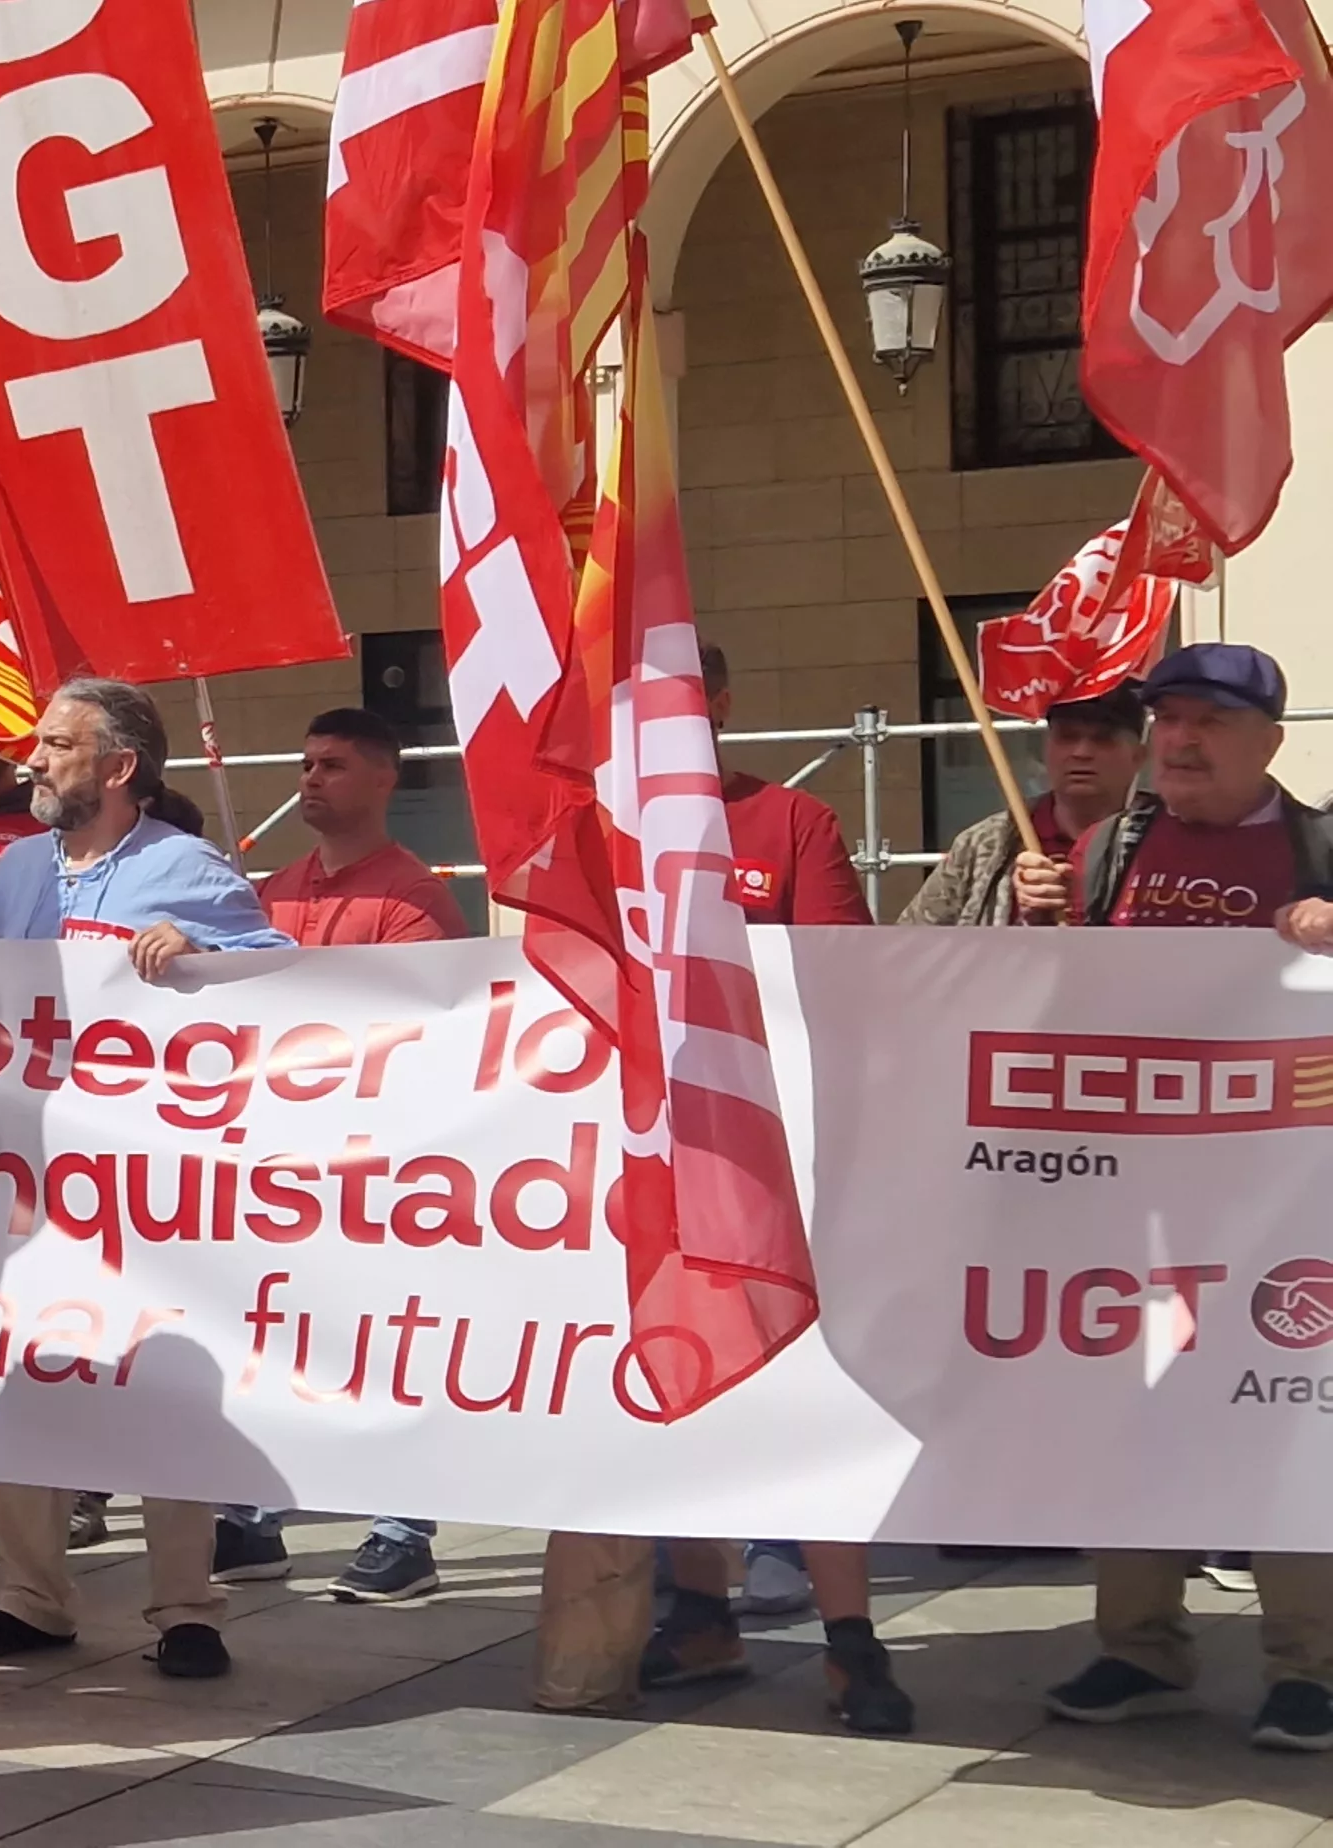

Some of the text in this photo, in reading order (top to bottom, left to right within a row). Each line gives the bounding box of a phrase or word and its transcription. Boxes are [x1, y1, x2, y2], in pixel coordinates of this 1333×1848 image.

[1126, 873, 1258, 916] HUGO
[473, 981, 620, 1094] lo
[990, 1052, 1274, 1115] CCOO
[965, 1141, 1118, 1183] Aragón
[964, 1264, 1227, 1359] UGT
[236, 1272, 713, 1425] futuro
[1231, 1369, 1333, 1413] Arag
